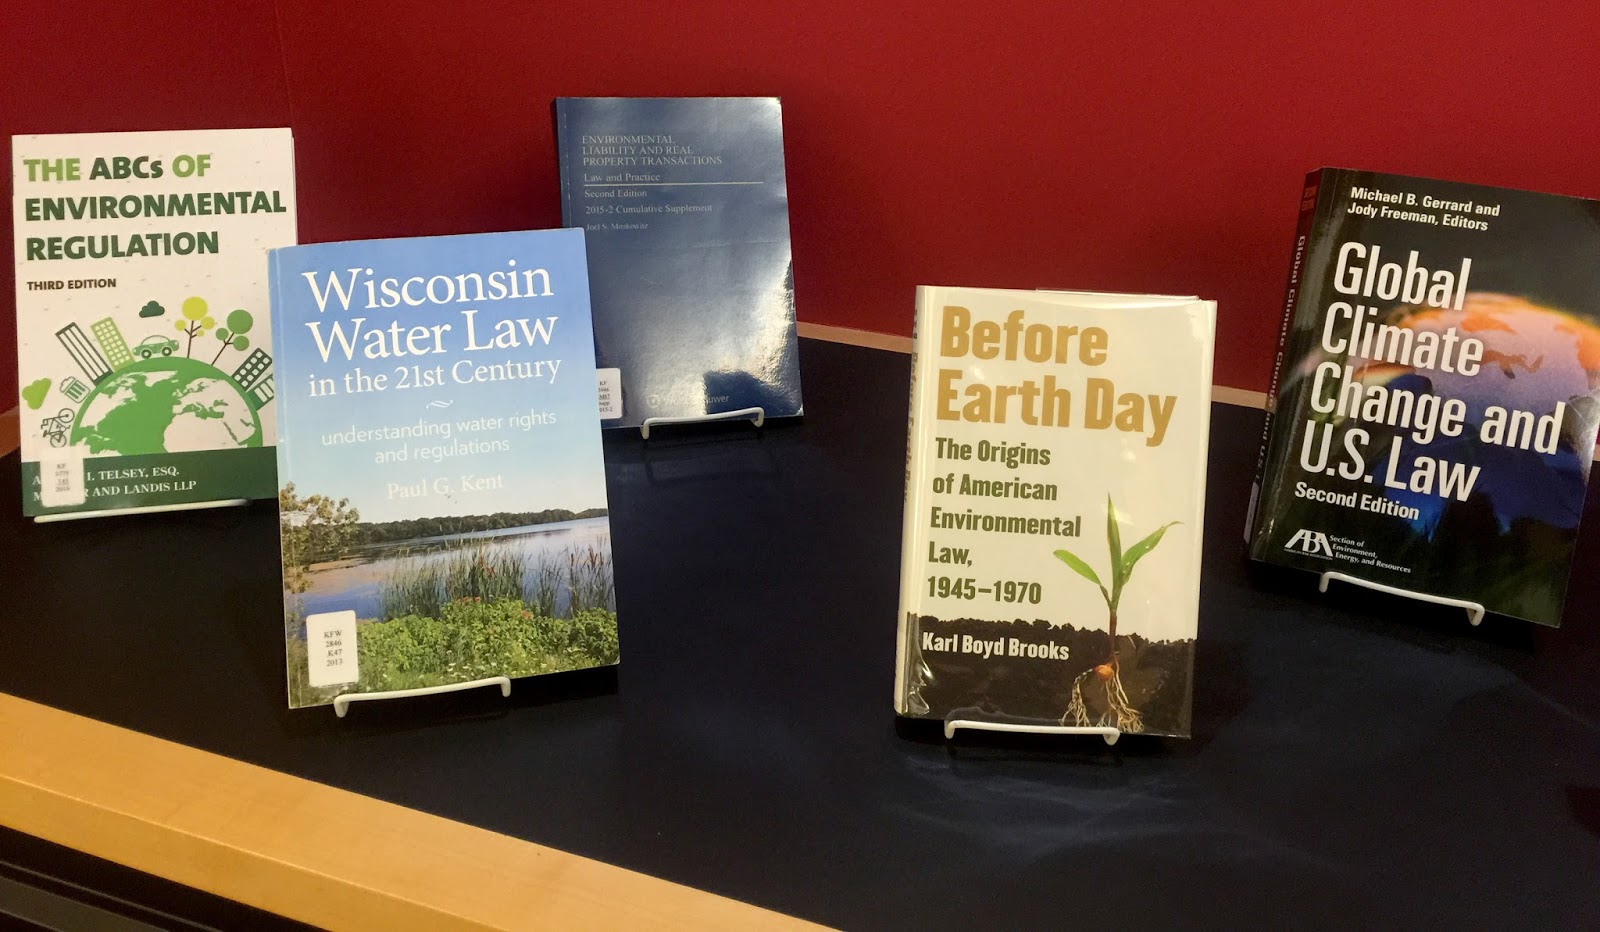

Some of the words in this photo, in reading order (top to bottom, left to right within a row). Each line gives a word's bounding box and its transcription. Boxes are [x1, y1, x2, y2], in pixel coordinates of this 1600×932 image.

[582, 135, 675, 144] ENVIRONMENTAL
[582, 146, 636, 156] LIABILITY
[640, 146, 664, 154] AND
[666, 146, 694, 154] REAL
[23, 158, 81, 182] THE
[89, 156, 163, 180] ABCs
[172, 154, 210, 178] OF
[583, 157, 637, 166] PROPERTY
[641, 156, 722, 166] TRANSACTIONS
[584, 174, 602, 182] Law
[606, 174, 622, 182] and
[626, 173, 660, 182] Practice
[25, 190, 286, 222] ENVIRONMENTAL
[584, 190, 614, 198] Second
[618, 190, 648, 198] Edition
[1350, 186, 1404, 204] Michael
[1406, 194, 1418, 206] B.
[1422, 196, 1473, 213] Gerrard
[1476, 204, 1501, 216] and
[586, 206, 614, 214] 2015-2
[616, 206, 662, 214] Cumulative
[665, 204, 712, 214] Supplement
[1348, 202, 1378, 218] Jody
[1380, 208, 1439, 226] Freeman,
[1442, 214, 1489, 231] Editors
[26, 231, 218, 261] REGULATION
[1291, 236, 1306, 284] Global
[27, 280, 64, 290] THIRD
[68, 278, 116, 290] EDITION
[302, 259, 554, 312] Wisconsin
[1334, 242, 1472, 311] Global
[1279, 288, 1296, 346] Climate
[305, 318, 452, 363] Water
[461, 310, 558, 351] Law
[940, 305, 1108, 366] Before
[1322, 301, 1484, 377] Climate
[309, 374, 336, 397] in
[344, 368, 388, 394] the
[395, 364, 445, 388] 21st
[452, 359, 562, 384] Century
[936, 368, 1072, 428] Earth
[1084, 378, 1178, 448] Day
[1310, 361, 1466, 444] Change
[1480, 401, 1566, 456] and
[321, 418, 450, 446] understanding
[457, 416, 504, 432] water
[510, 408, 556, 431] rights
[375, 443, 408, 464] and
[414, 437, 510, 462] regulations
[936, 437, 972, 460] The
[978, 440, 1051, 469] Origins
[1300, 420, 1373, 484] U.S.
[1384, 436, 1482, 502] Law
[98, 468, 148, 480] TELSEY,
[152, 466, 180, 478] ESQ.
[388, 480, 427, 500] Paul
[433, 478, 455, 494] G.
[462, 474, 504, 492] Kent
[932, 473, 954, 494] of
[959, 474, 1058, 500] American
[92, 487, 120, 496] AND
[124, 482, 170, 495] LANDIS
[174, 480, 197, 492] LLP
[1295, 481, 1357, 508] Second
[1360, 494, 1420, 520] Edition
[930, 506, 1082, 538] Environmental
[928, 541, 972, 568] Law,
[1284, 528, 1334, 556] ABA
[1330, 535, 1355, 546] Section
[1332, 544, 1378, 559] Environment,
[1336, 552, 1360, 564] Energy,
[1376, 560, 1412, 574] Resources
[324, 630, 342, 638] KFW
[922, 632, 958, 652] Karl
[962, 634, 1004, 660] Boyd
[1008, 638, 1070, 660] Brooks
